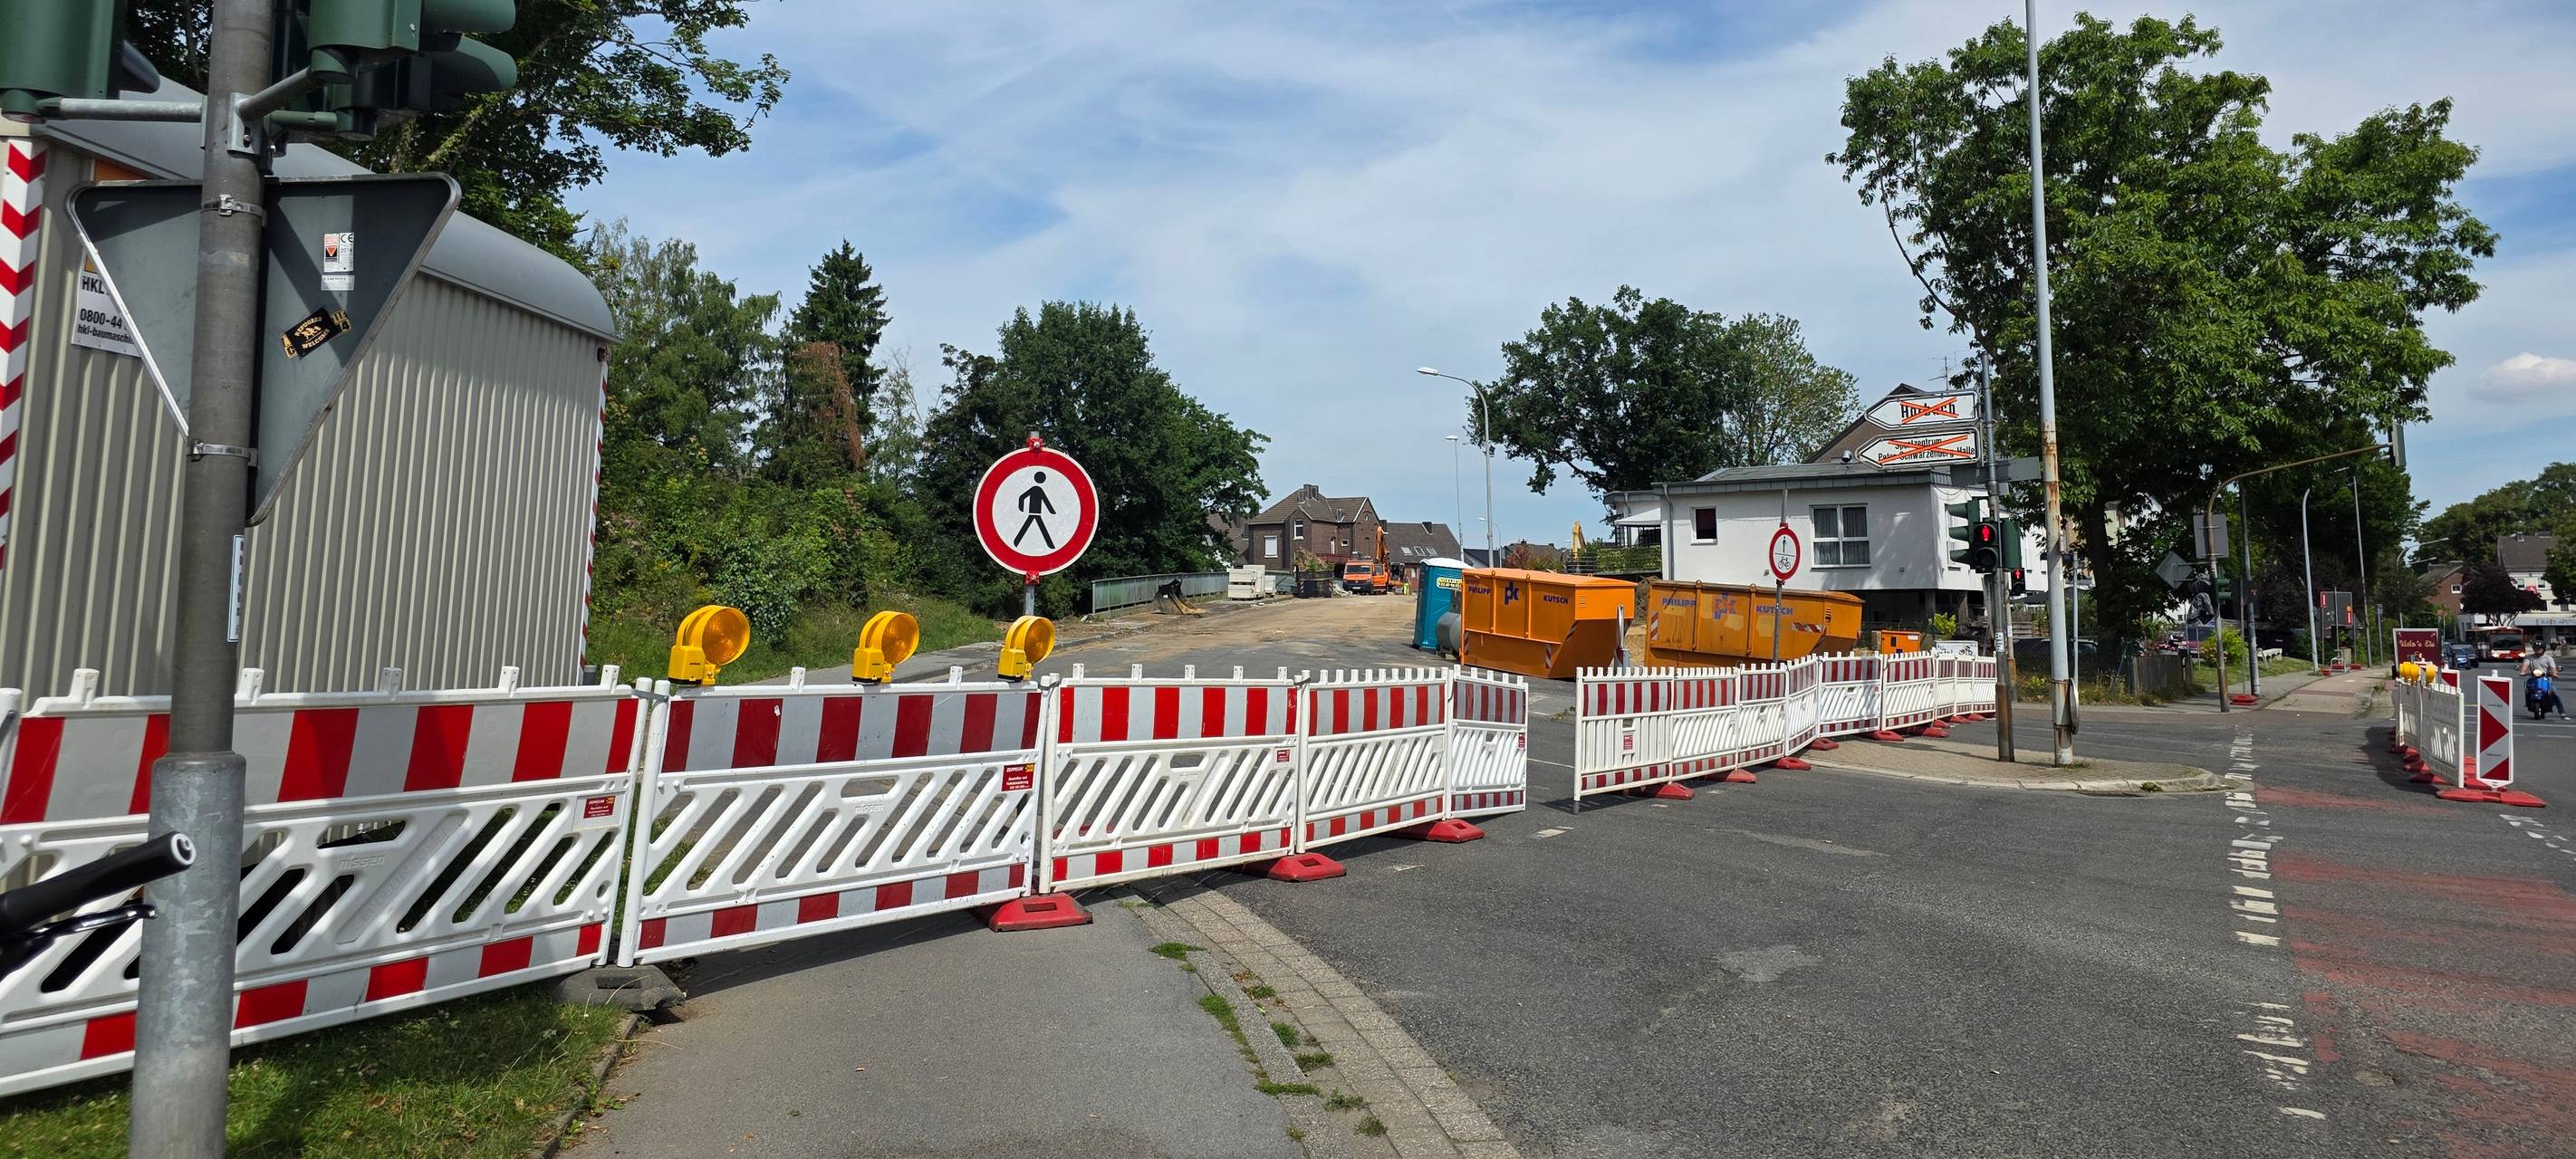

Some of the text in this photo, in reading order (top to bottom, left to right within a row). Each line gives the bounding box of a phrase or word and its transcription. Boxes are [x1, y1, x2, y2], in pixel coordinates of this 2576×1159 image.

[82, 275, 105, 294] HKL
[80, 308, 123, 330] 0800-44
[294, 317, 322, 337] REFUGEES
[302, 328, 331, 349] WELCOME
[1901, 401, 1956, 418] Hobch
[1468, 586, 1491, 595] PHILIPP
[1543, 594, 1569, 605] KUTSCH
[1662, 598, 1696, 607] PHILIPP
[1756, 605, 1793, 615] KUTCH
[855, 803, 884, 814] nissen
[339, 852, 385, 869] nissen
